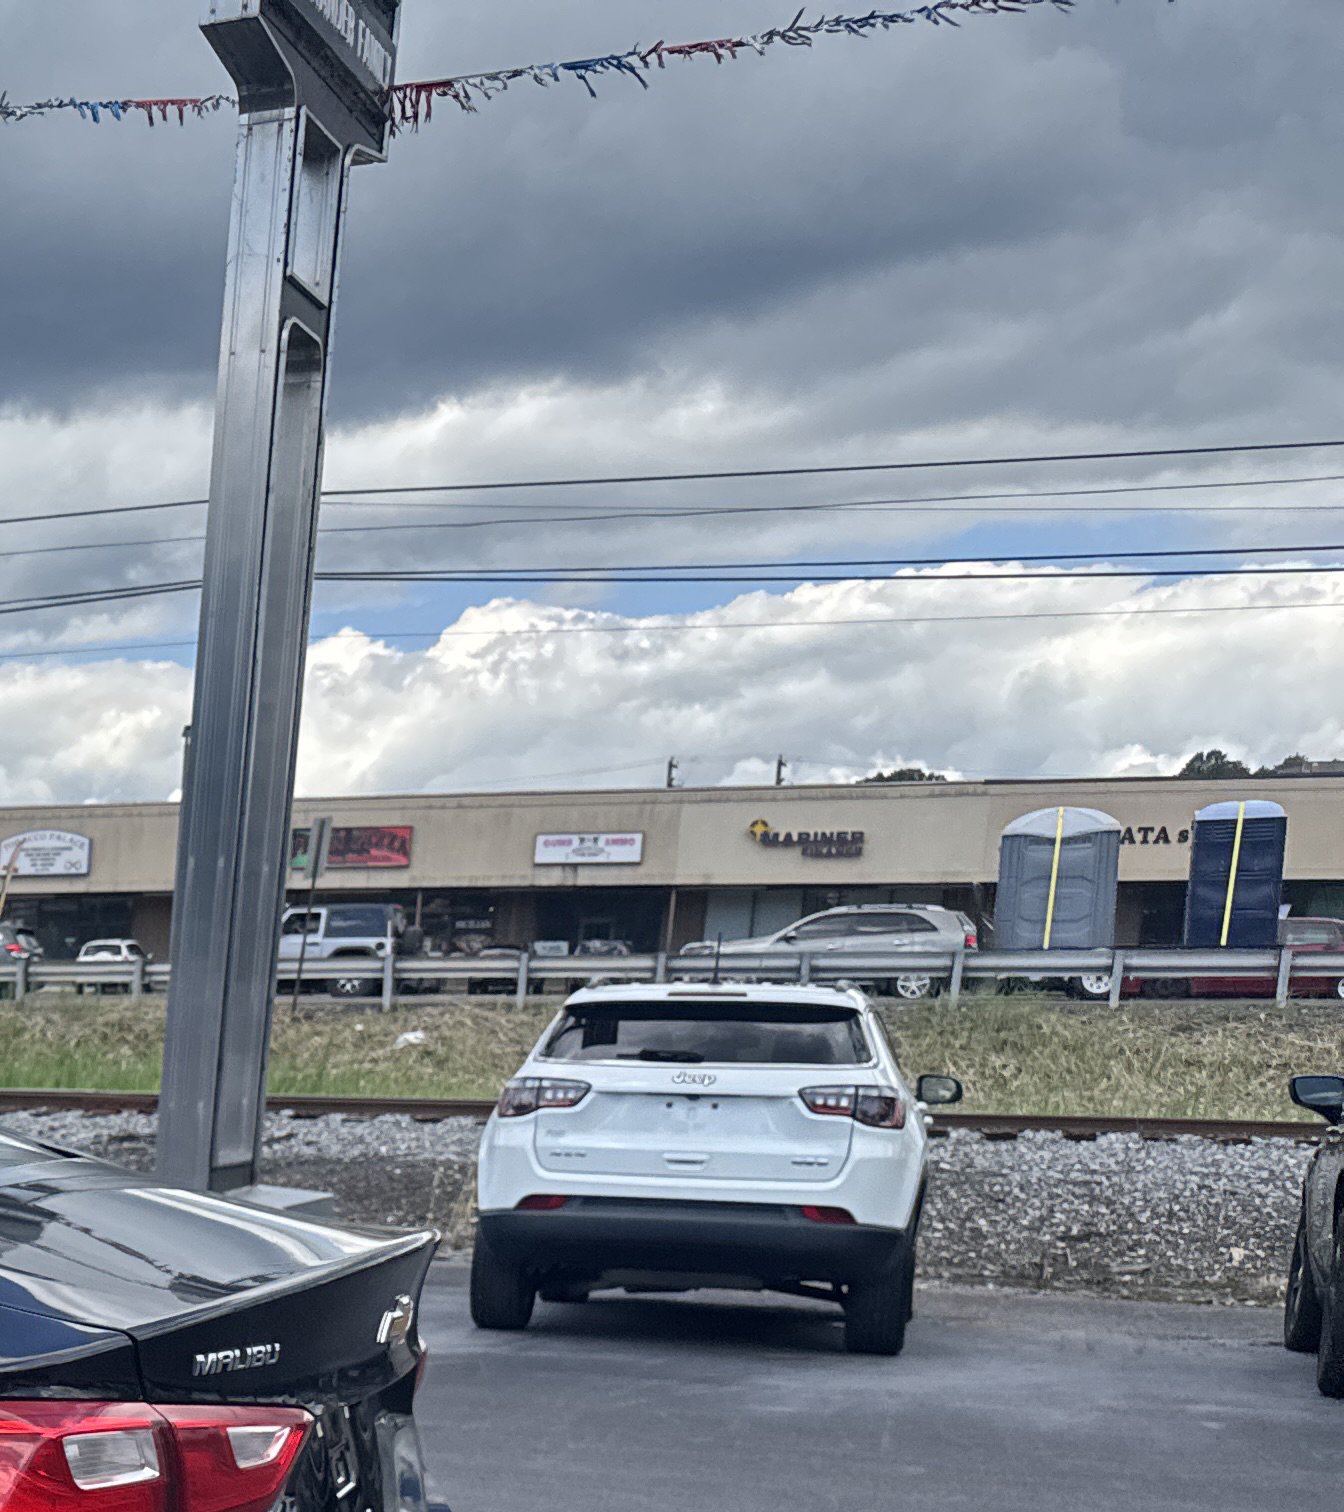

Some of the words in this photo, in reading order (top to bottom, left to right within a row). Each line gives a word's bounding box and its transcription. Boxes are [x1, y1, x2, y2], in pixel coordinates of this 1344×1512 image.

[760, 831, 864, 847] MARINER
[672, 1071, 717, 1087] Jeep
[192, 1343, 280, 1376] MALIBU
